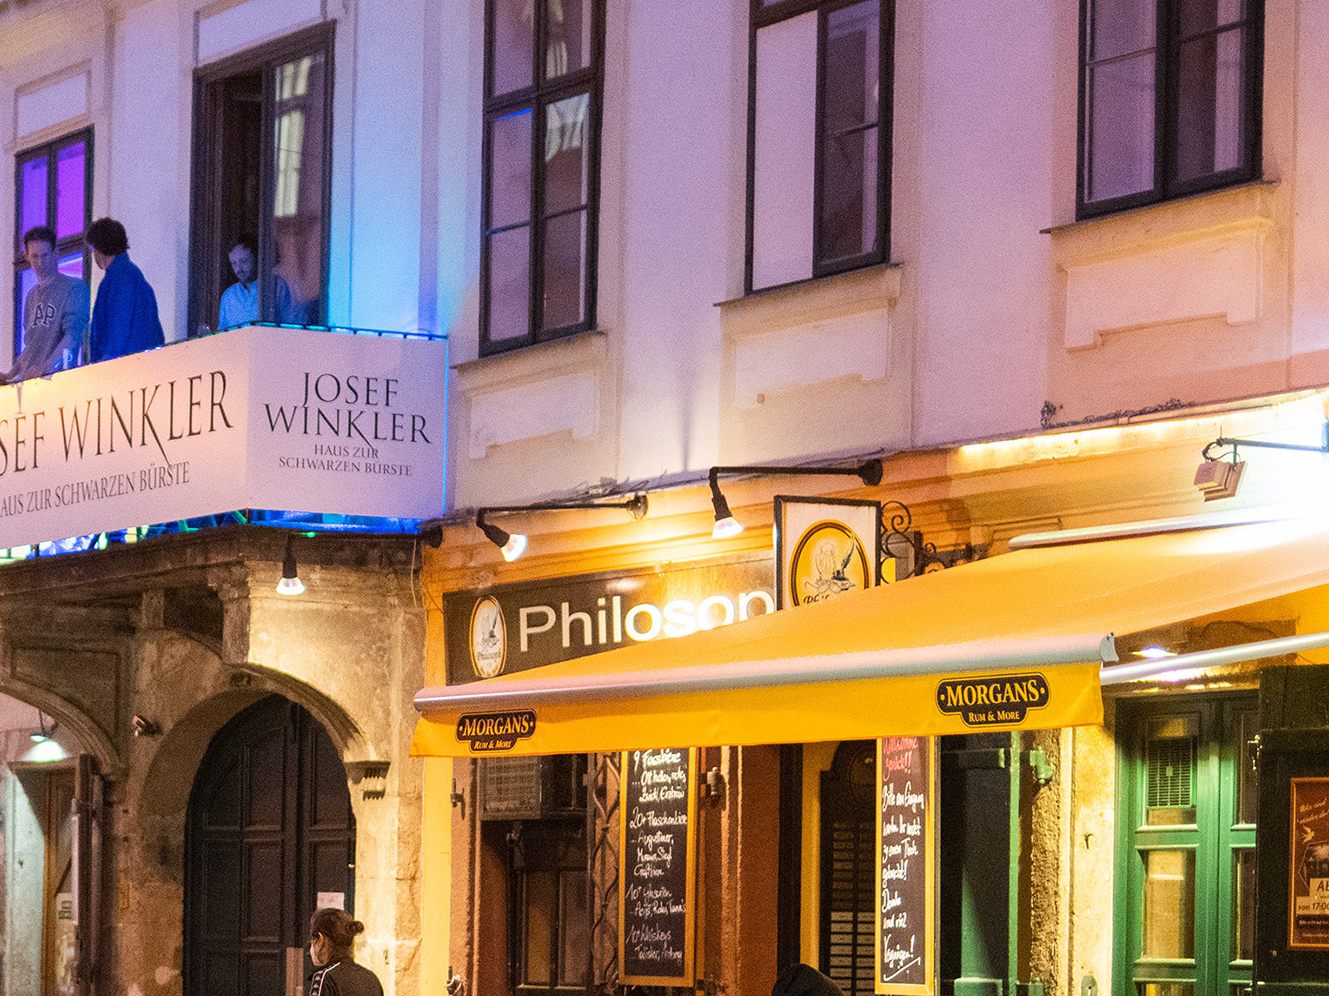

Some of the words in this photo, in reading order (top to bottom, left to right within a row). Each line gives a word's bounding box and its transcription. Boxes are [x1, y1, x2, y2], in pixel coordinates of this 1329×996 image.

[303, 372, 399, 407] JOSEF
[58, 370, 234, 467] WINKLER
[264, 403, 432, 449] WINKLER
[279, 456, 361, 473] SCHWARZEN
[314, 444, 349, 457] HAUS
[352, 446, 379, 460] ZUR
[26, 489, 53, 523] ZUR
[55, 471, 136, 507] SCHWARZEN
[139, 461, 190, 495] BÜRSTE
[945, 680, 1040, 707] MORGANS
[462, 715, 529, 737] MORGANS
